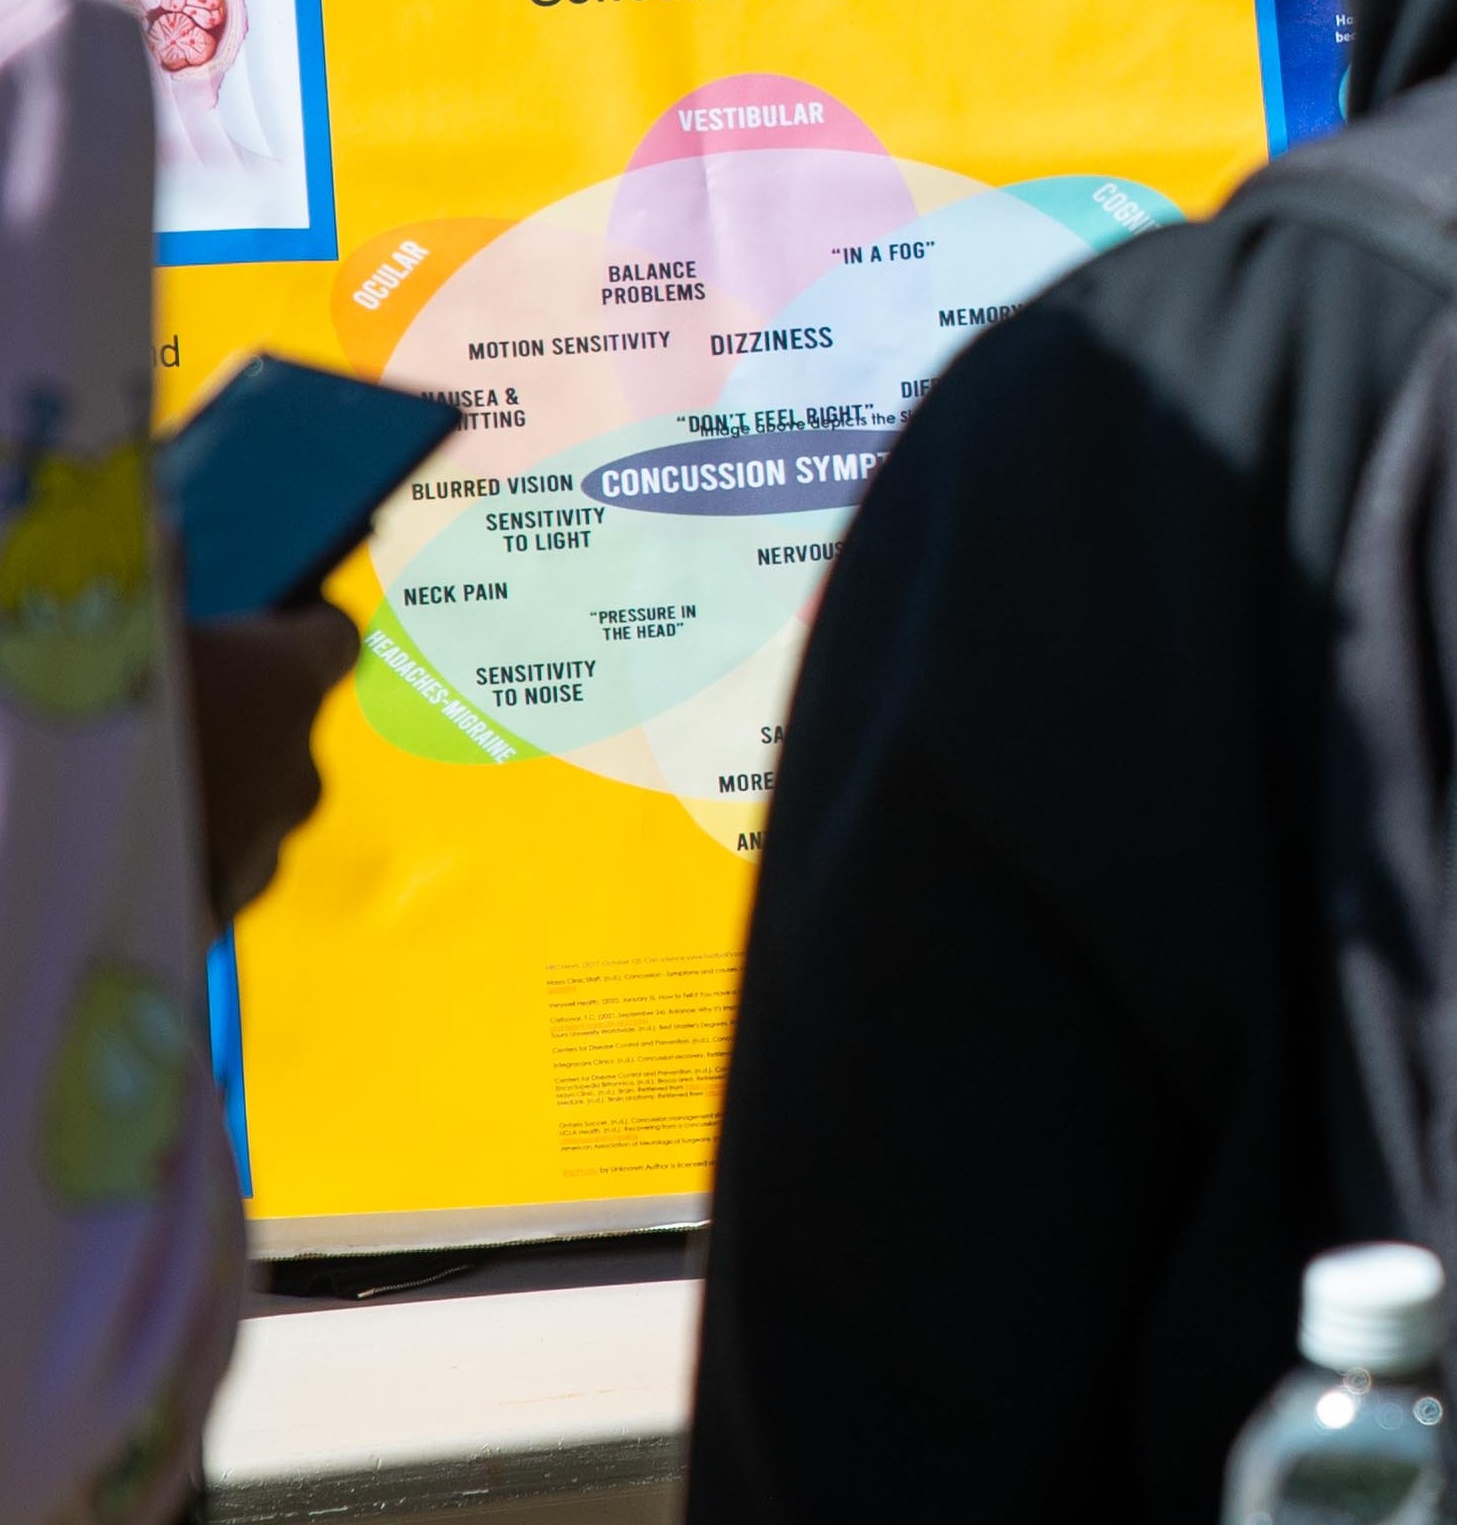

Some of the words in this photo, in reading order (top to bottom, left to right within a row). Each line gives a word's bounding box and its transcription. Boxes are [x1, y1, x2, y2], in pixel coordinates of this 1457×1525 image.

[678, 102, 825, 133] VESTIBULAR
[871, 245, 882, 262] A
[890, 241, 935, 261] FOG”
[352, 240, 430, 311] OCULAR
[608, 261, 697, 283] BALANCE
[602, 282, 706, 306] PROBLEMS
[469, 339, 545, 360] MOTION
[552, 331, 670, 355] SENSITIVITY
[711, 326, 834, 356] DIZZINESS
[505, 387, 519, 405] &
[755, 409, 794, 431] FEEL
[872, 413, 896, 425] the
[412, 478, 501, 500] BLURRED
[507, 474, 573, 495] VISION
[602, 459, 785, 497] CONCUSSION
[486, 507, 605, 531] SENSITIVITY
[503, 534, 528, 553] TO
[535, 530, 591, 551] LIGHT
[404, 585, 456, 606] NECK
[463, 582, 508, 602] PAIN
[681, 605, 696, 619] IN
[603, 627, 632, 641] THE
[476, 660, 596, 685] SENSITIVITY
[493, 689, 517, 707] TO
[526, 684, 583, 705] NOISE
[718, 771, 774, 793] MORE
